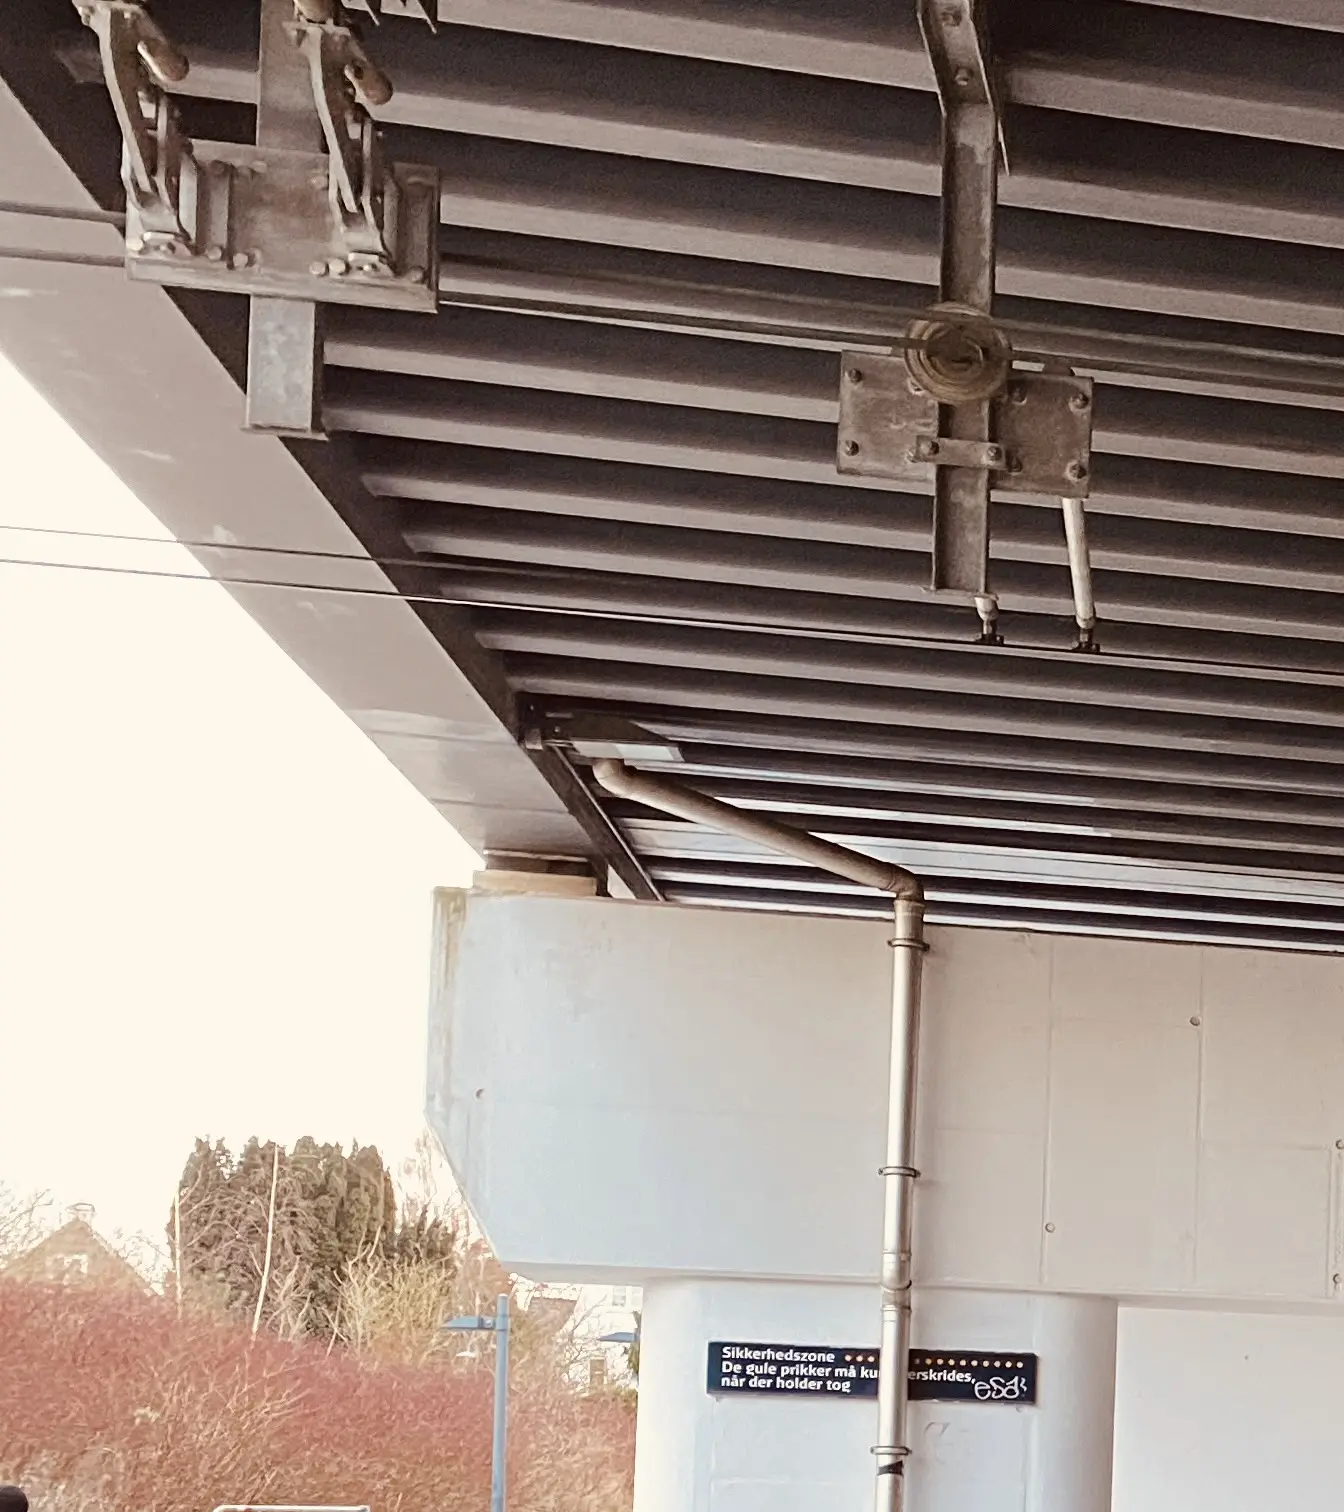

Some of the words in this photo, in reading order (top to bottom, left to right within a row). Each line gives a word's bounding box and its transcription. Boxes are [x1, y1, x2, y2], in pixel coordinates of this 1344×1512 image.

[721, 1346, 836, 1363] Sikkerhedszone
[721, 1361, 742, 1374] De
[745, 1362, 778, 1377] gule
[780, 1363, 831, 1378] prikker
[834, 1366, 857, 1378] må
[860, 1366, 880, 1379] ku
[721, 1375, 745, 1388] når
[748, 1376, 773, 1389] der
[776, 1377, 823, 1390] holder
[826, 1380, 852, 1393] tog
